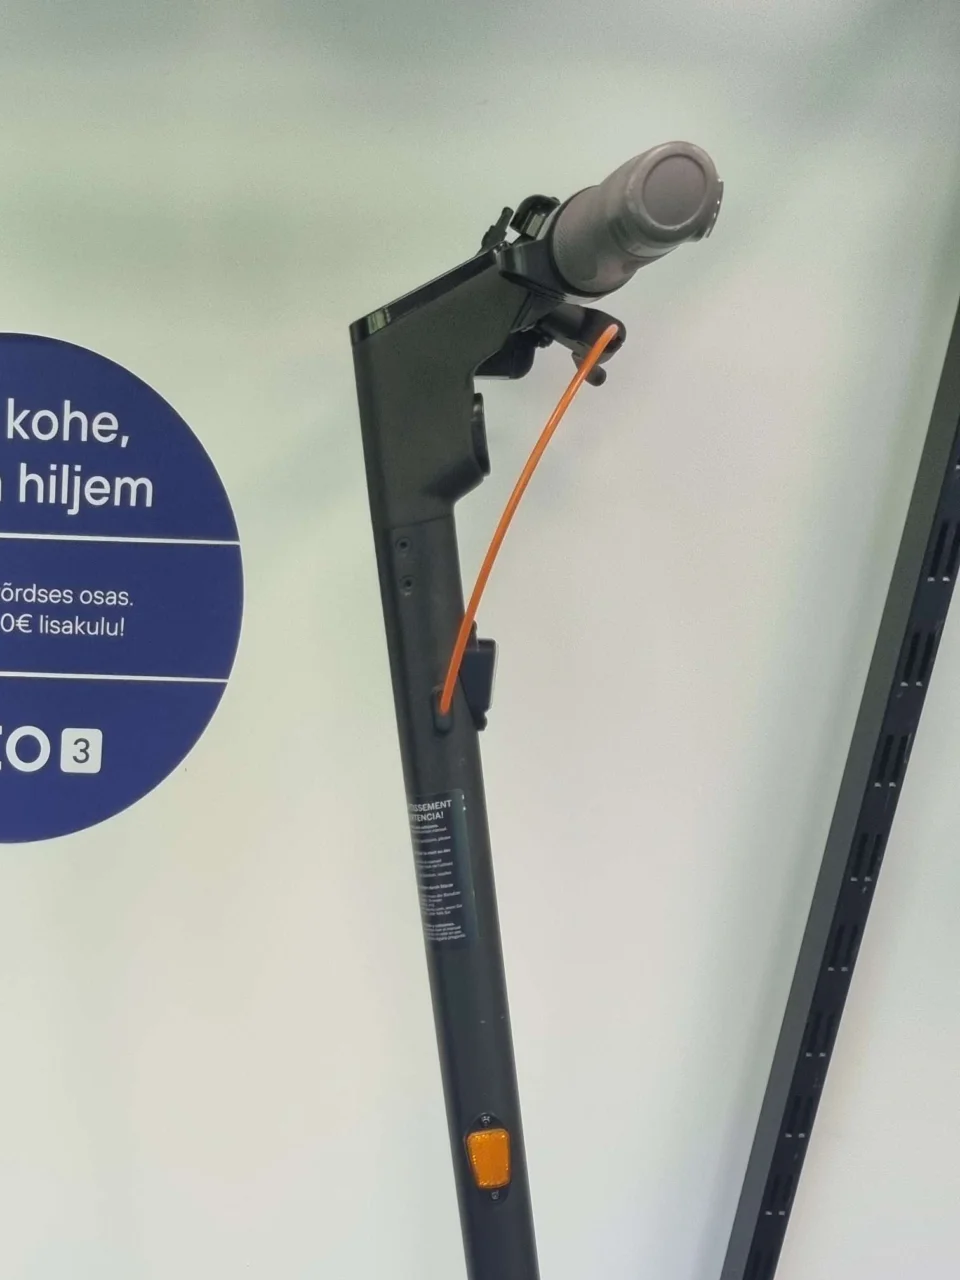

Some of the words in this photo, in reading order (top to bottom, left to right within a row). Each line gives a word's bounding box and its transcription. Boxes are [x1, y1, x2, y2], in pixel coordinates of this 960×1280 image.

[7, 398, 129, 448] kohe,
[19, 462, 153, 515] hiljem
[79, 589, 134, 607] osas.
[0, 613, 33, 634] 0€
[39, 615, 125, 637] lisakulu!
[72, 737, 91, 764] 3
